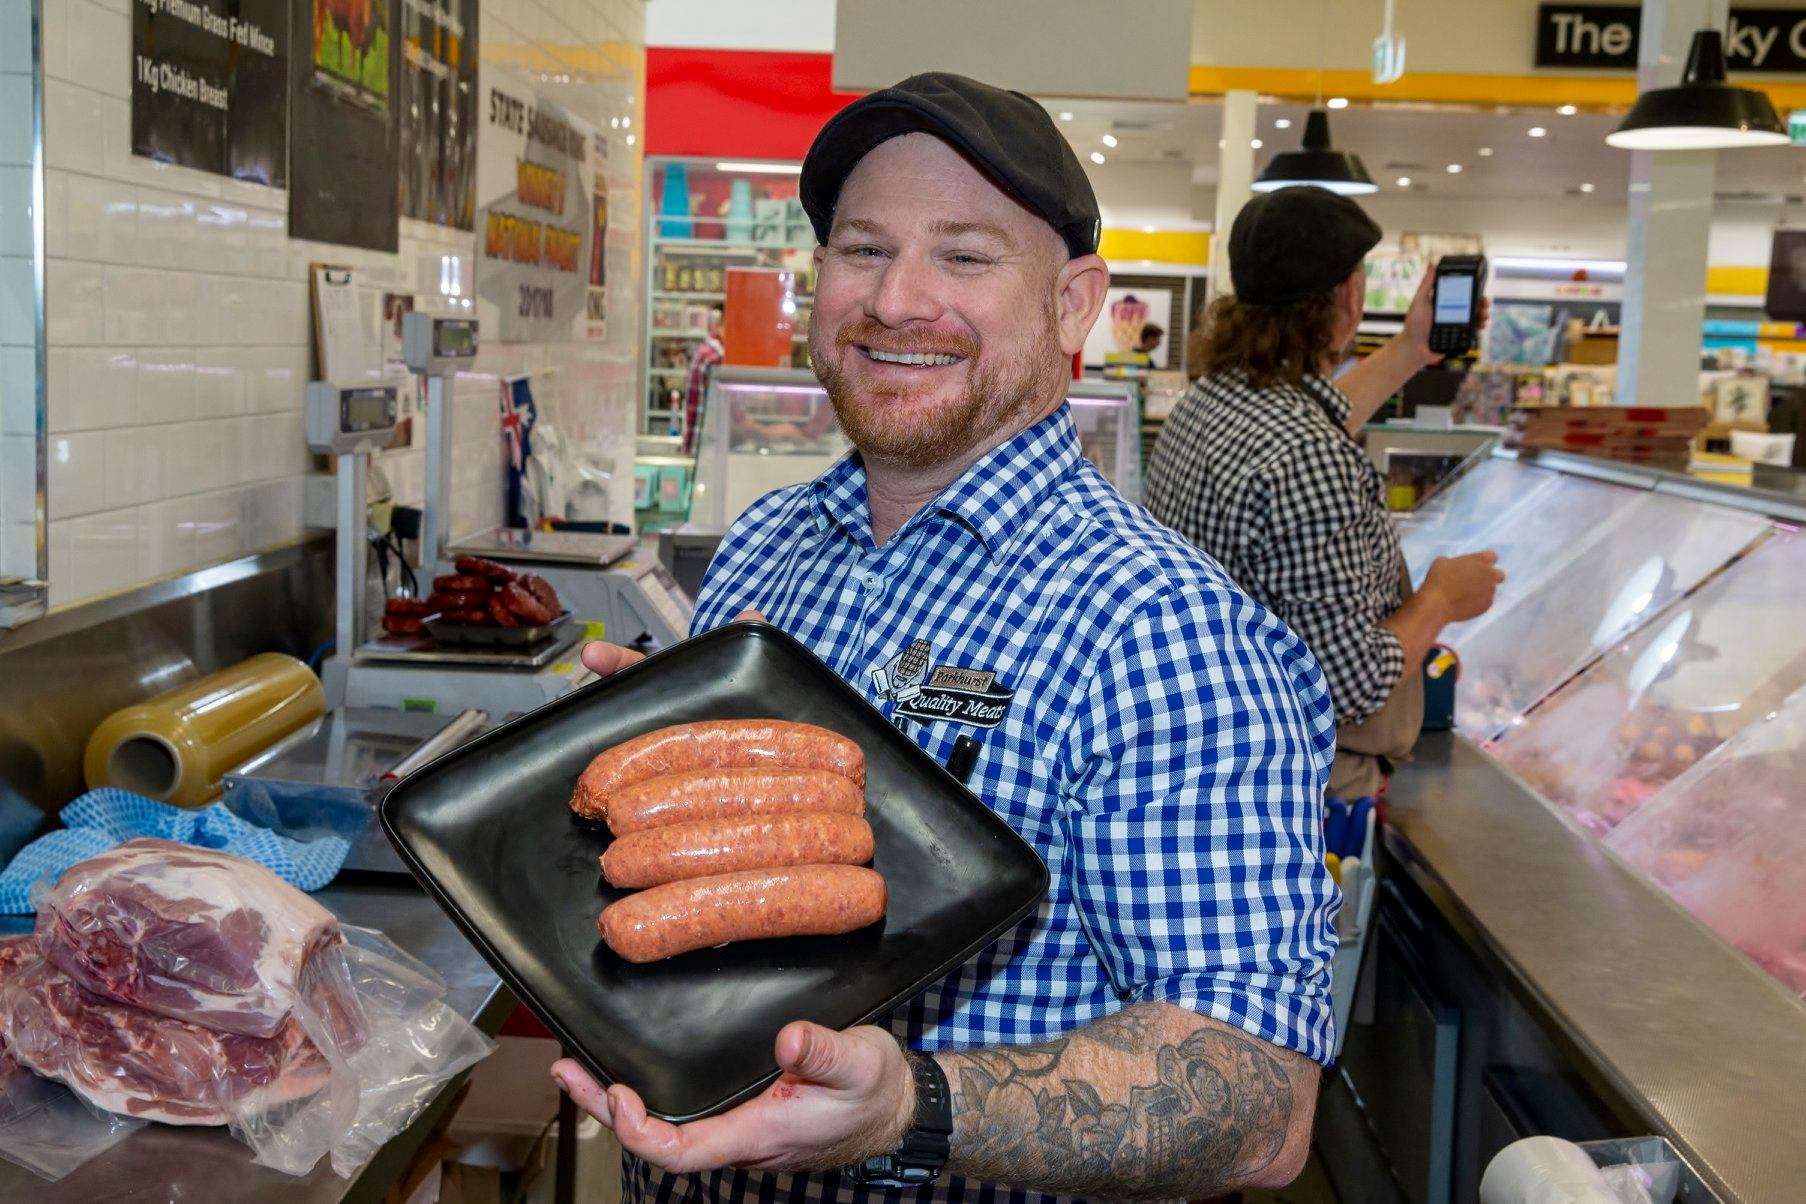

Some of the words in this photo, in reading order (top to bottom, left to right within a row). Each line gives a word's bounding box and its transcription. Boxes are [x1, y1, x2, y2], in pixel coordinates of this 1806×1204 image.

[202, 5, 228, 39] Grass
[229, 17, 248, 46] Fed
[249, 22, 275, 57] Mince
[1552, 13, 1632, 56] The
[136, 55, 159, 93] 1Kg
[160, 63, 199, 100] Chicken
[199, 78, 228, 110] Breast
[934, 671, 989, 687] Parkhurst
[909, 693, 963, 716] Quality
[962, 699, 1006, 719] Meats
